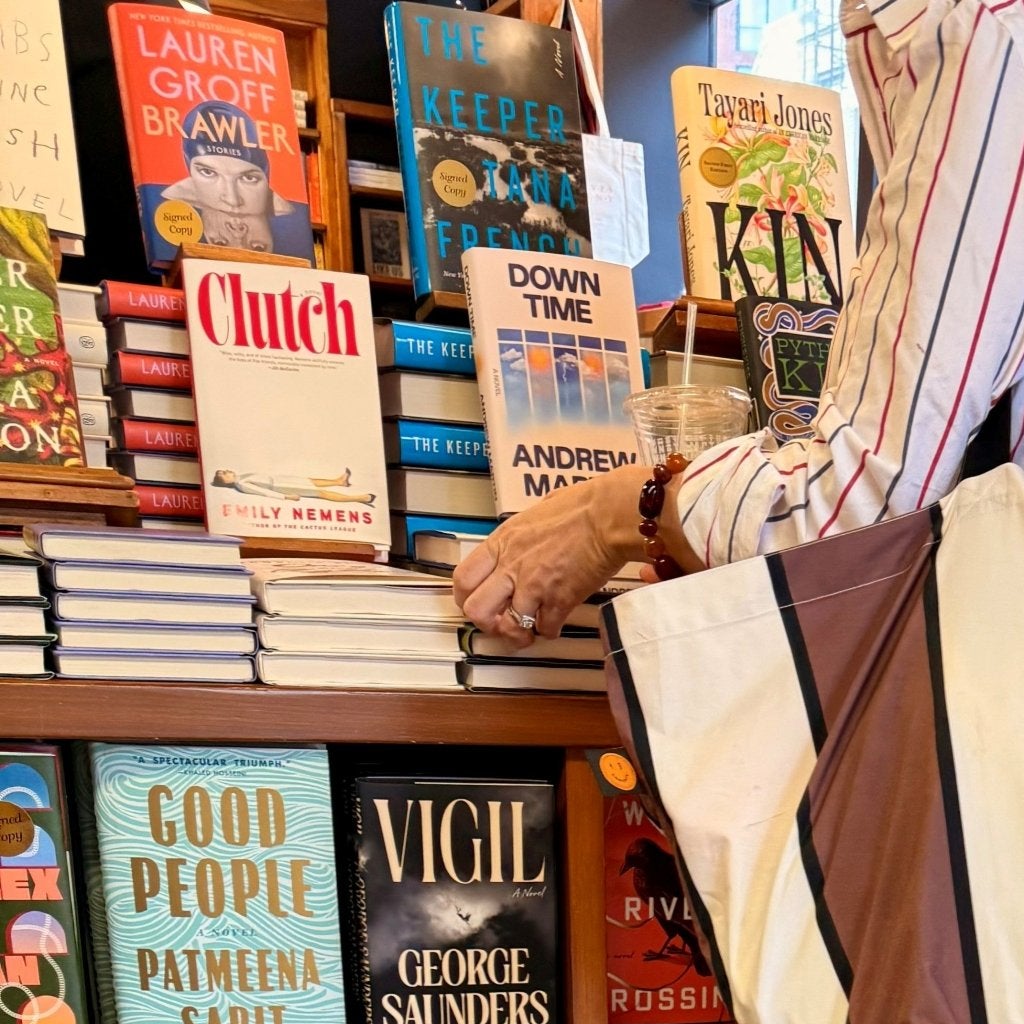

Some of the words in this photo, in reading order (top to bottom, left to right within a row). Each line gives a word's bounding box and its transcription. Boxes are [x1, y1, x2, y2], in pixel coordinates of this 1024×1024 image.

[137, 25, 278, 78] LAUREN
[416, 16, 489, 66] THE
[148, 66, 277, 113] GROFF
[421, 85, 566, 144] KEEPER
[697, 82, 769, 128] Tayari
[773, 93, 834, 137] Jones
[141, 104, 296, 156] BRAWLER
[206, 145, 242, 158] STORIES
[439, 171, 468, 184] Signed
[443, 183, 467, 199] Copy
[482, 158, 578, 211] TANA
[162, 211, 193, 224] Signed
[168, 223, 193, 236] Copy
[706, 201, 843, 305] KIN
[508, 262, 602, 297] DOWN
[197, 271, 361, 357] Clutch
[523, 293, 594, 324] TIME
[407, 338, 434, 356] THE
[10, 380, 39, 410] A
[413, 436, 440, 453] THE
[512, 443, 637, 474] ANDREW
[221, 504, 281, 520] EMILY
[292, 507, 373, 525] NEMENS
[153, 756, 227, 767] SPECTACULAR
[234, 758, 291, 768] TRIUMPH."
[147, 784, 287, 849] GOOD
[372, 797, 547, 885] VIGIL
[130, 856, 315, 919] PEOPLE
[511, 888, 522, 898] A
[521, 887, 547, 899] Novel
[211, 928, 258, 938] NOVEL
[137, 948, 322, 992] PATMEENA
[398, 948, 531, 988] GEORGE
